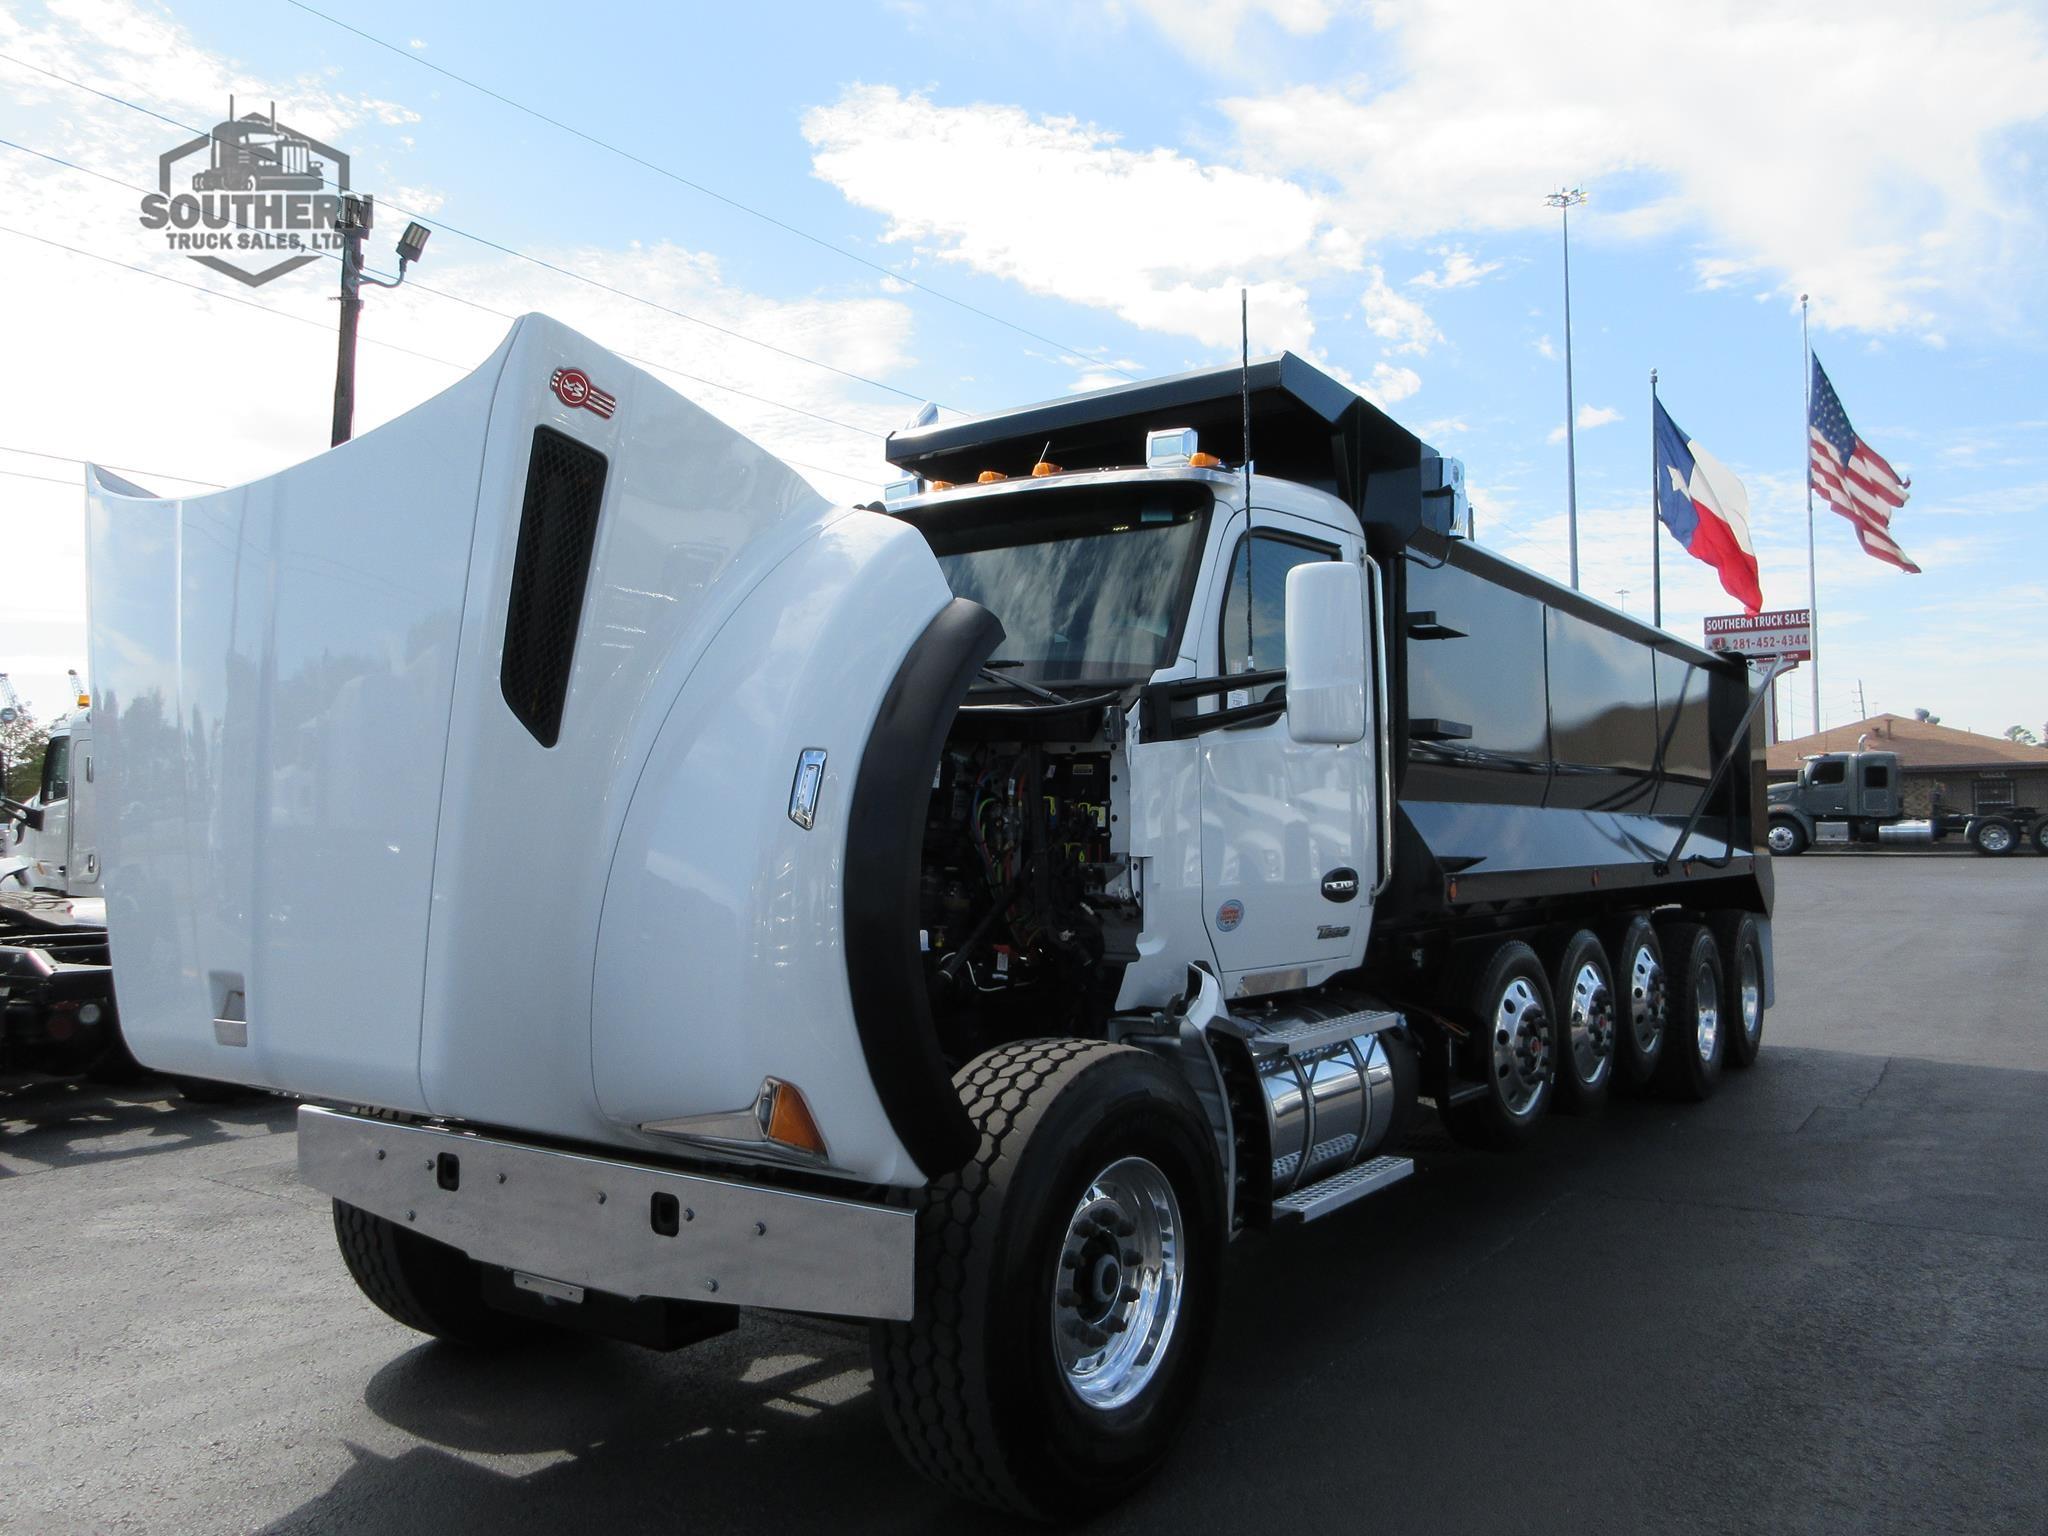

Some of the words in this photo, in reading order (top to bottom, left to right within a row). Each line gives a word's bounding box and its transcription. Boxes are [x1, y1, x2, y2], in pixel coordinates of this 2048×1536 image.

[1706, 617, 1753, 631] SOUTHERN
[1754, 614, 1784, 627] TRUCK
[1784, 612, 1811, 625] SALES
[1733, 634, 1808, 650] 281-452-4344
